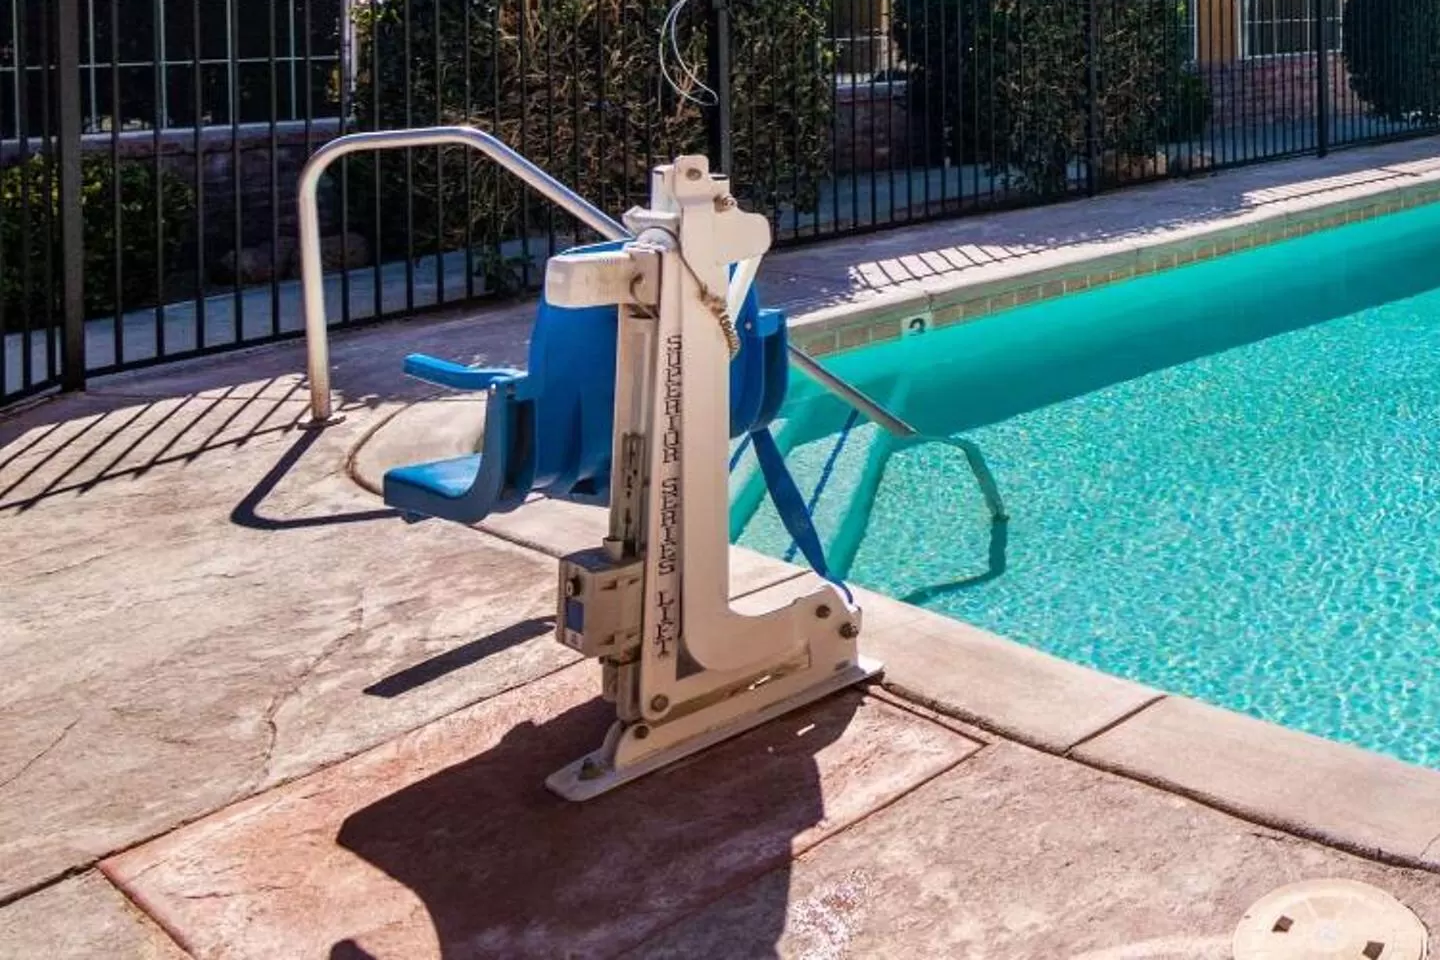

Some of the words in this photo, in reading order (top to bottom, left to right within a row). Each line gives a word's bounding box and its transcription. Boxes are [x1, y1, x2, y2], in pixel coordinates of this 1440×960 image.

[662, 335, 682, 463] SUPERIOR
[658, 477, 678, 576] SERIES
[654, 591, 675, 659] LIFT
